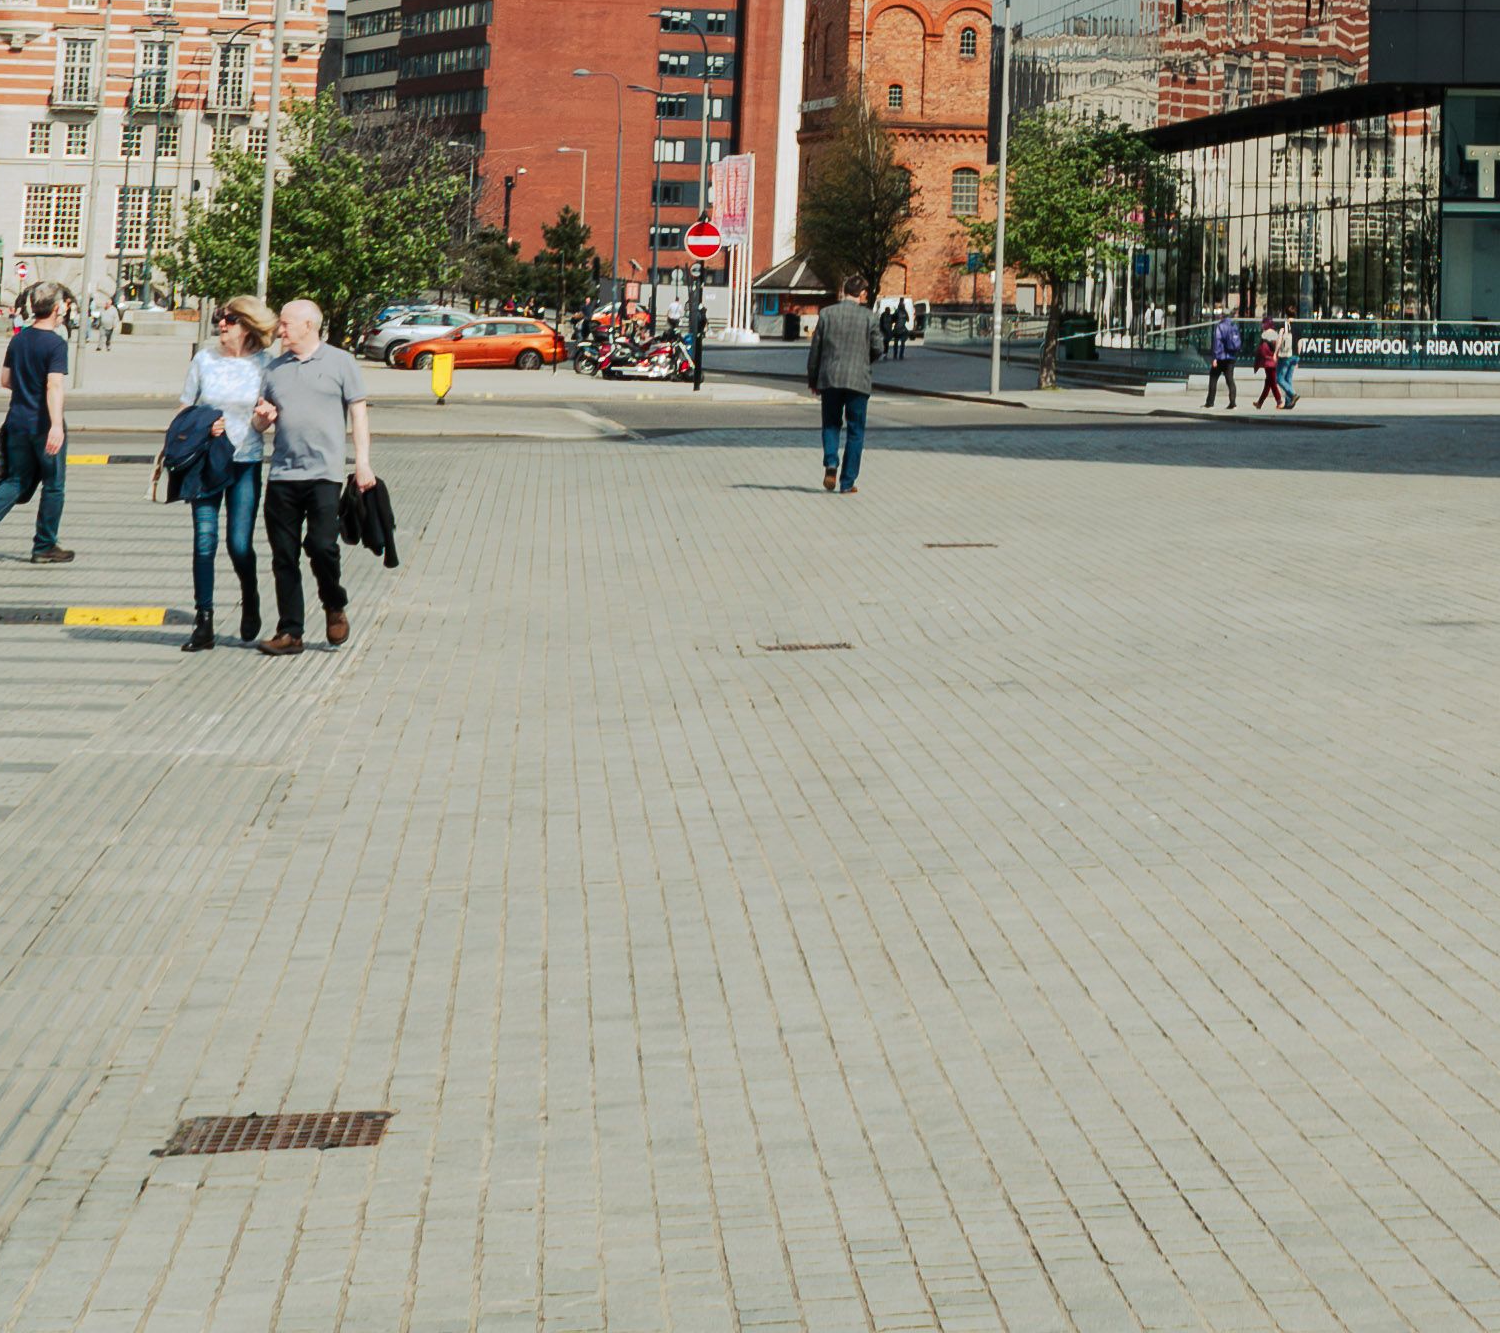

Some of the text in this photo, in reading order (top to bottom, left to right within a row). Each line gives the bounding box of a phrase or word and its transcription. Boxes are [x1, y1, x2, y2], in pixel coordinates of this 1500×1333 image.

[1300, 337, 1331, 354] TATE
[1335, 338, 1409, 355] LIVERPOOL
[1426, 339, 1459, 356] RIBA
